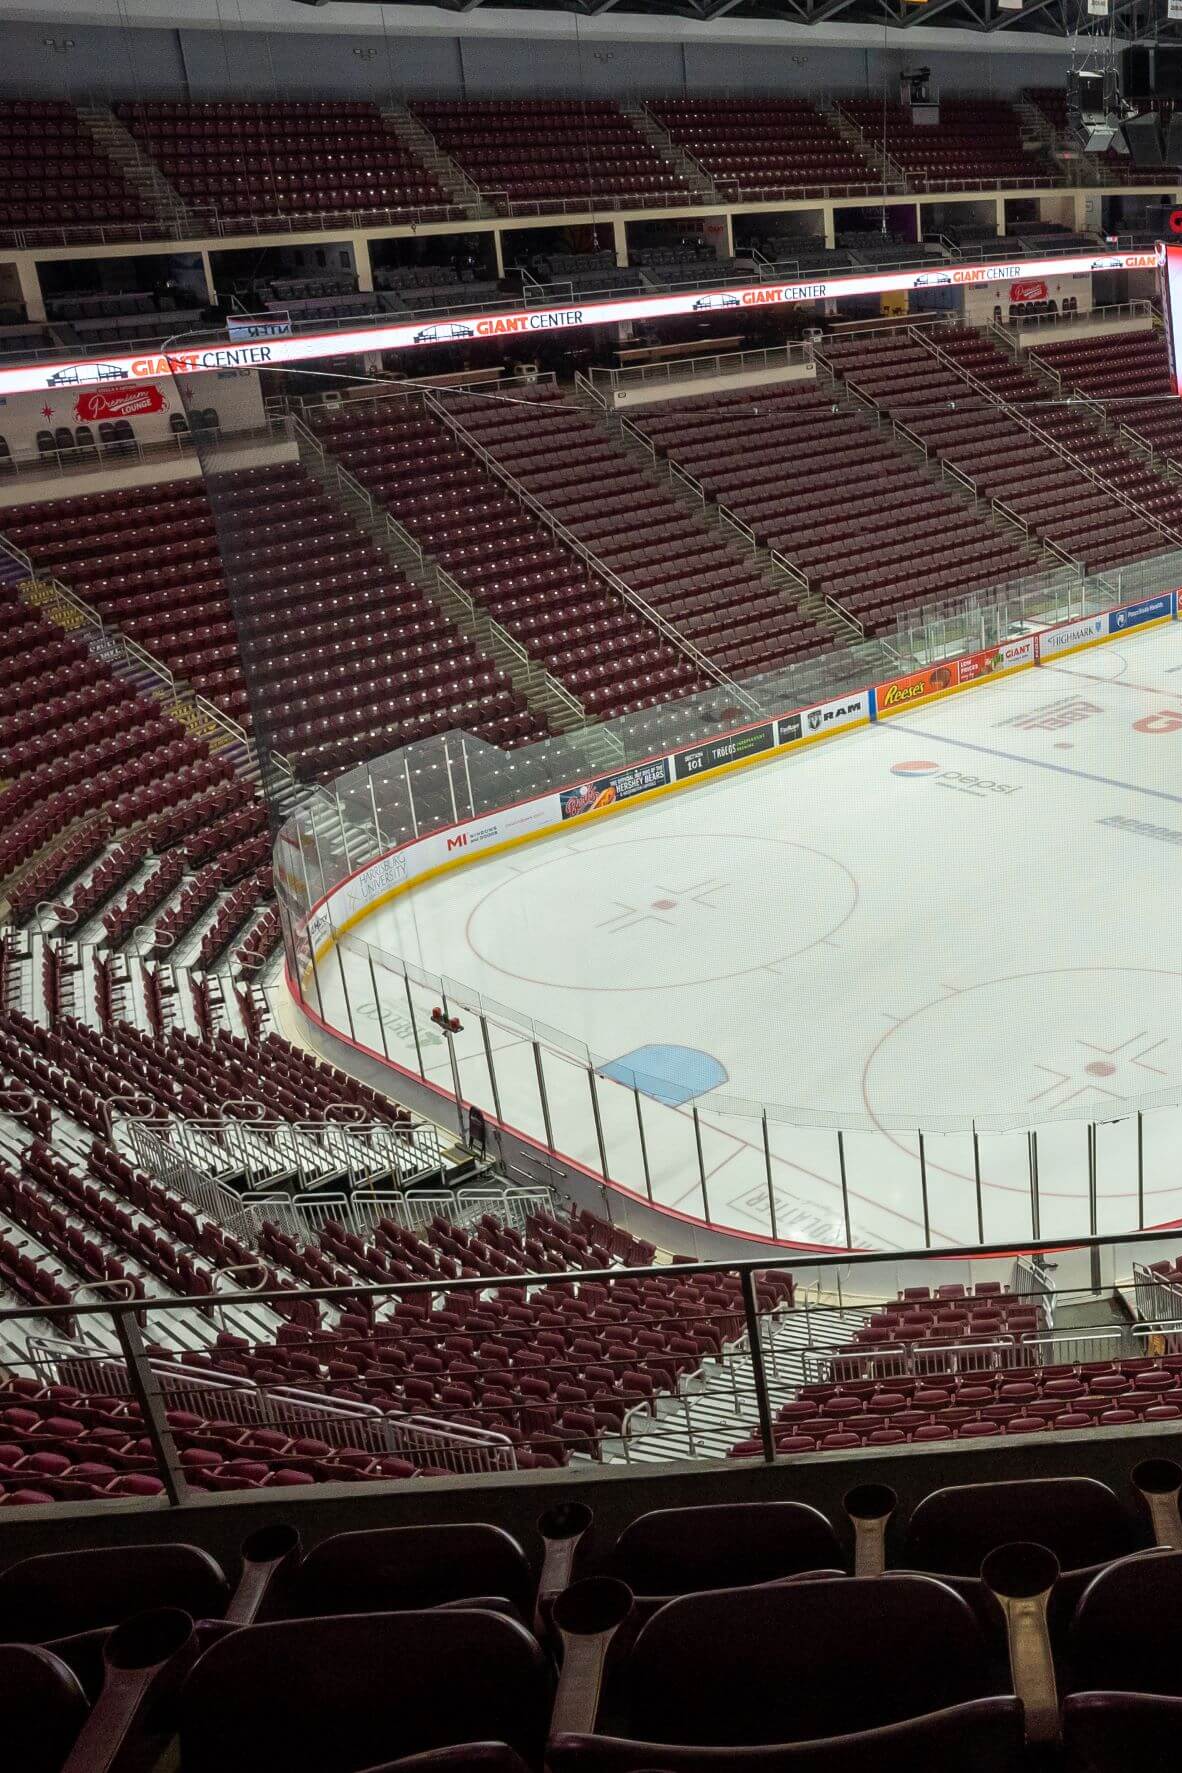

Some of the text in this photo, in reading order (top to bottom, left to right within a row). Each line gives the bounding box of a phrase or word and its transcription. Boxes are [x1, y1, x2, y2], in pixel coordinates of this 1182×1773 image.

[1125, 256, 1157, 267] GIAN
[953, 266, 1021, 283] GIANT CENTER
[742, 284, 827, 304] GIANT CENTER
[476, 310, 584, 336] GIANT CENTER
[131, 346, 272, 377] GIANT CENTER
[88, 390, 150, 418] Premium
[121, 399, 153, 416] LOUNGE
[1050, 625, 1094, 647] HIGHMARK
[1005, 643, 1031, 659] GIANT
[823, 701, 862, 721] RAM
[687, 760, 703, 772] 101
[615, 777, 645, 793] HERSHEY
[936, 771, 1023, 794] pepsi
[446, 832, 468, 852] MI
